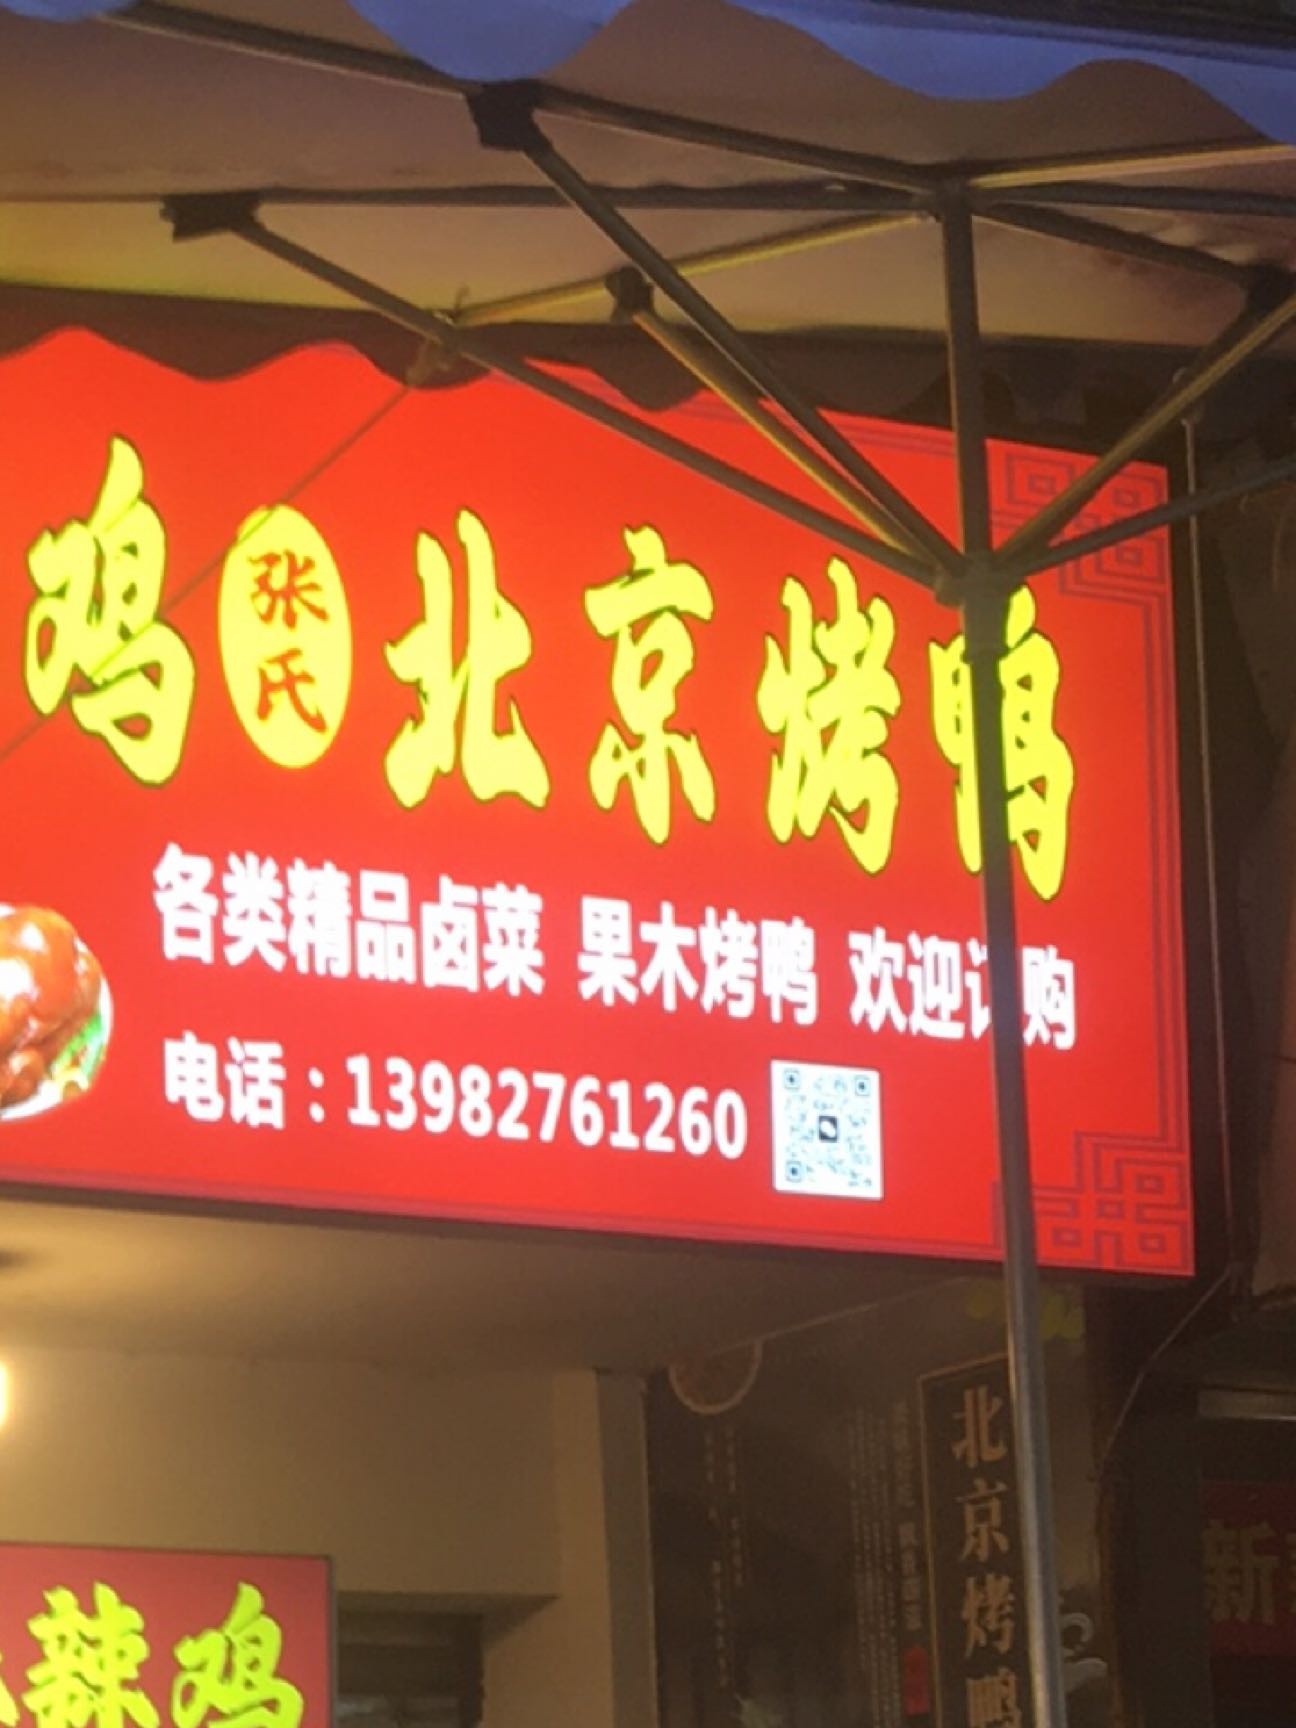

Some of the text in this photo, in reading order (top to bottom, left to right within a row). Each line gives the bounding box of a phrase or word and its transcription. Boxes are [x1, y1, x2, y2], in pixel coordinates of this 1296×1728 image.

[248, 549, 330, 733] 张氏
[384, 507, 1076, 902] 北京烤鸭
[154, 843, 545, 997] 各类精品卤菜
[578, 896, 818, 1025] 果木烤鸭
[1201, 1518, 1296, 1626] 新
